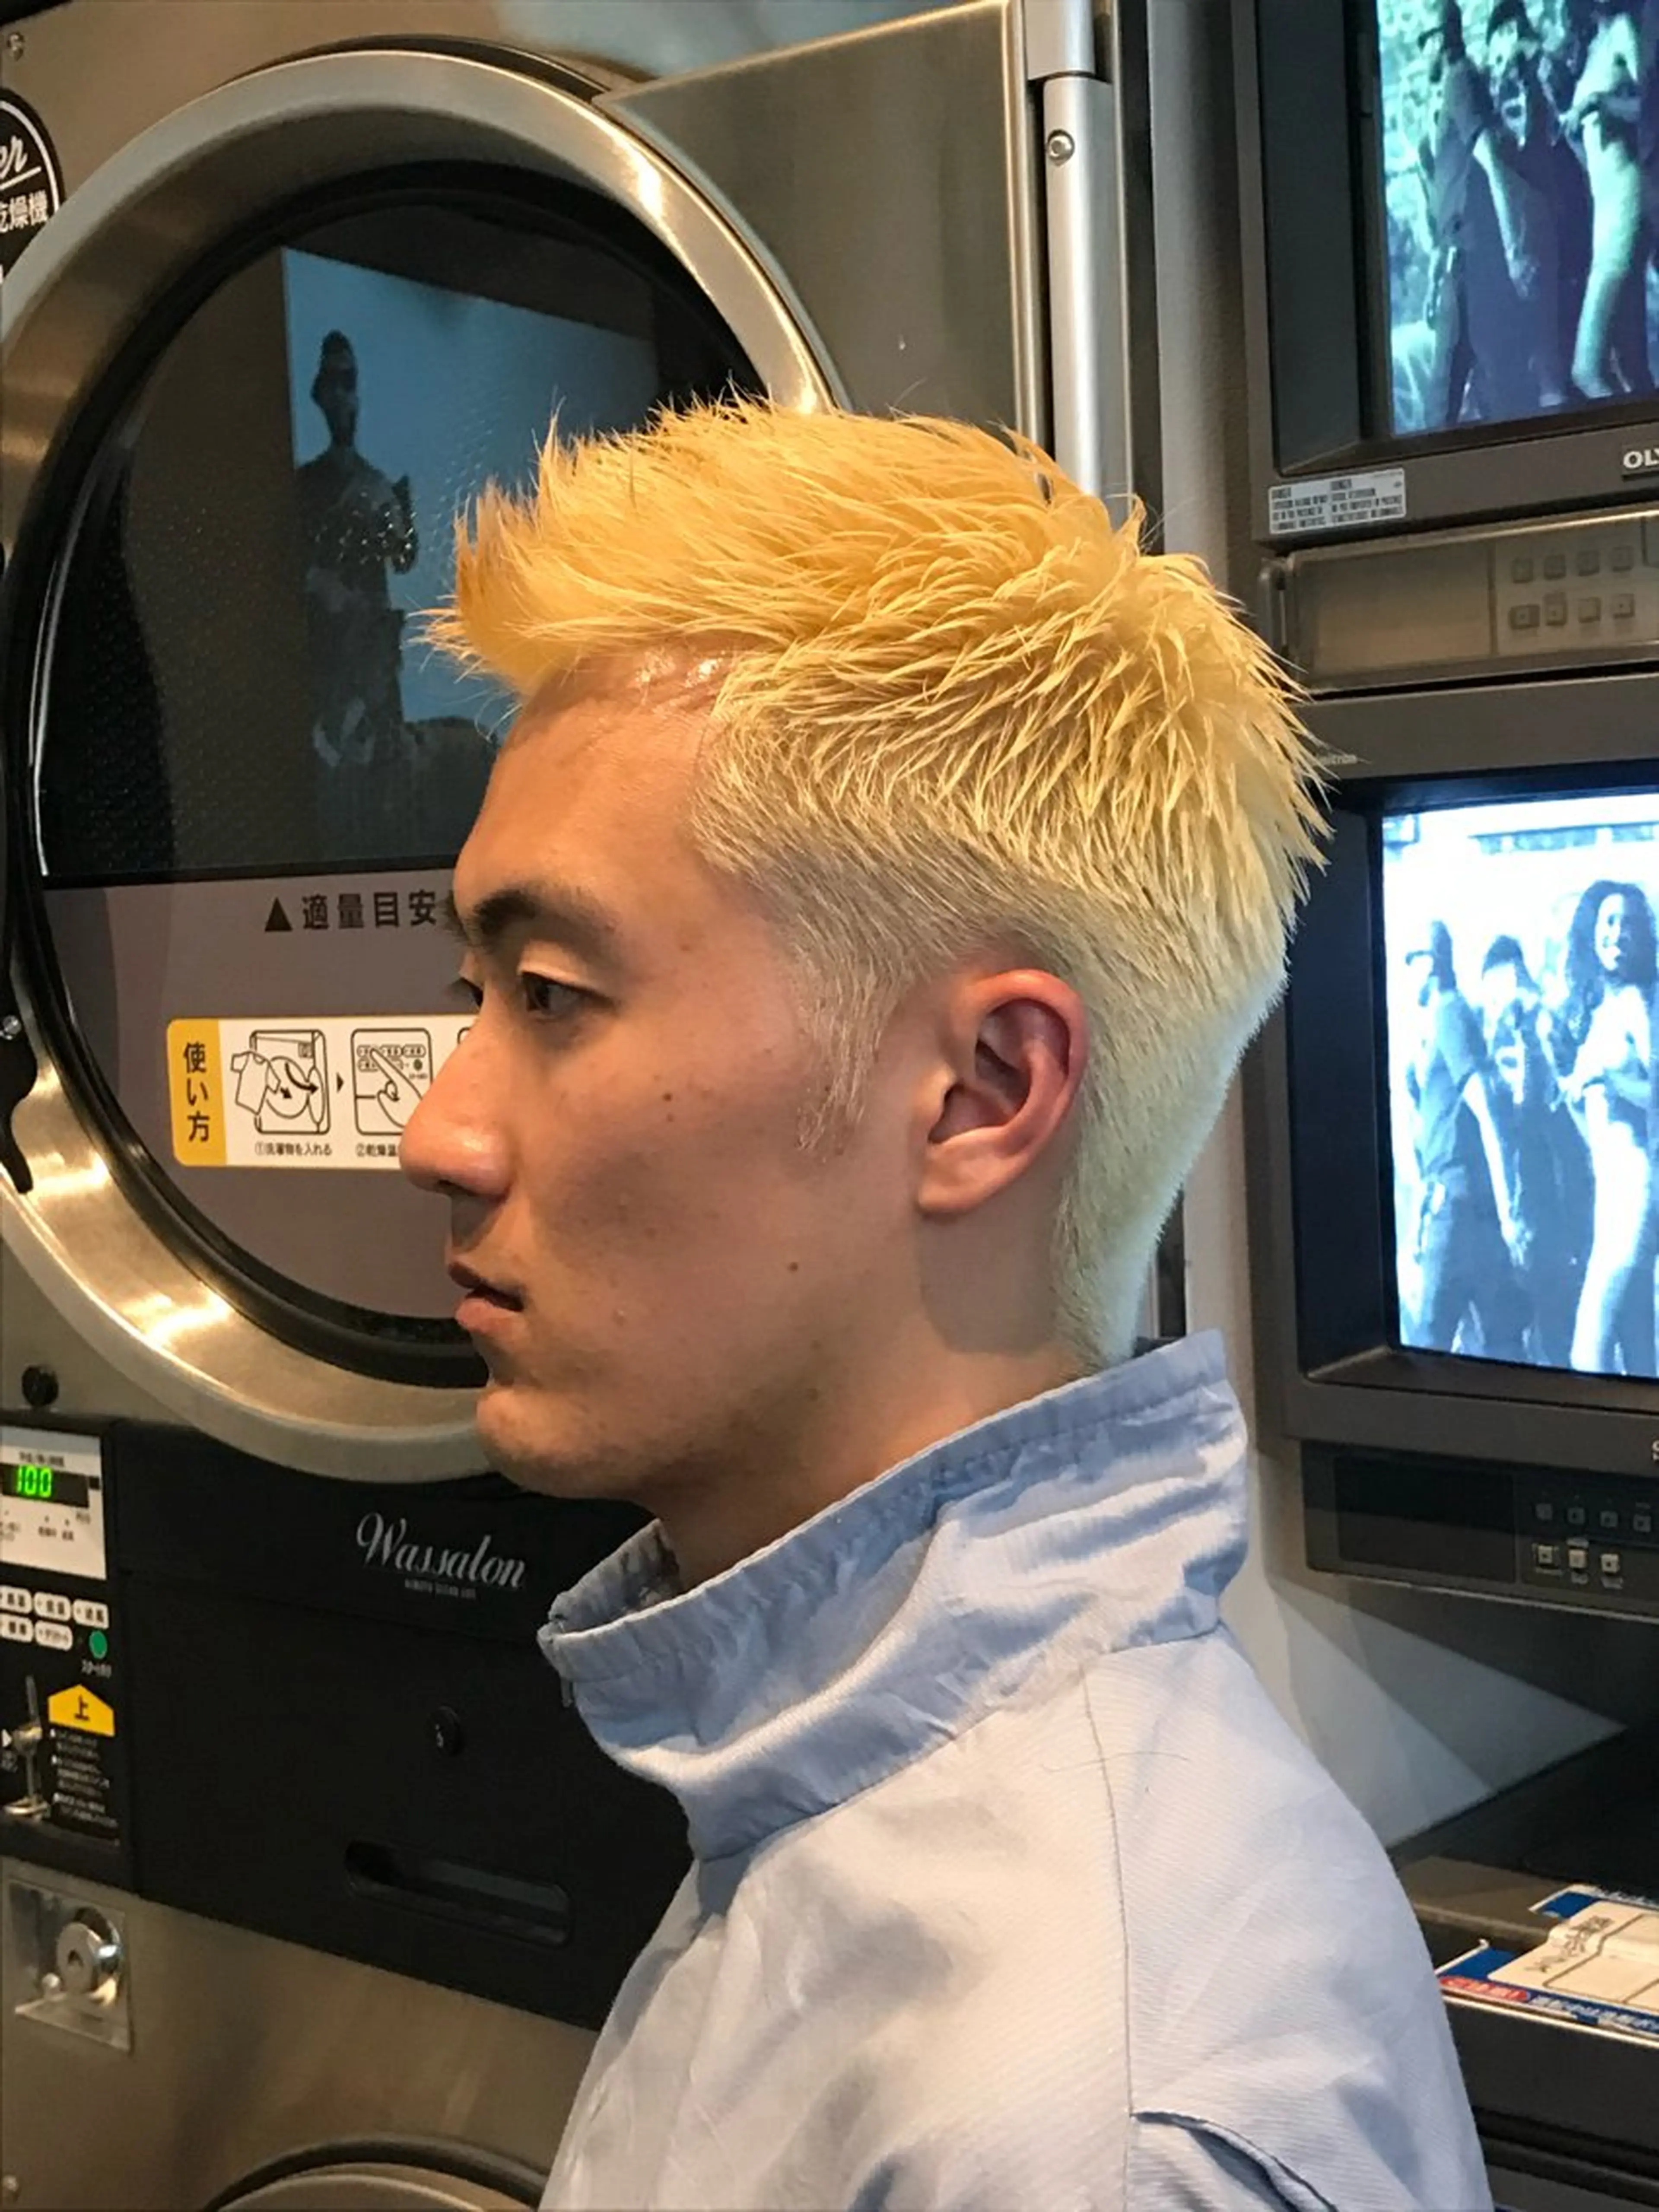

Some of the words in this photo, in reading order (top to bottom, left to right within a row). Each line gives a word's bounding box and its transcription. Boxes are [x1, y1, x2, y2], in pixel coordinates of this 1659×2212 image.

[302, 889, 436, 930] 適量目安
[183, 1042, 210, 1142] 使い方
[16, 1465, 52, 1497] 100
[356, 1513, 525, 1587] Wassalon
[74, 1694, 89, 1721] 上
